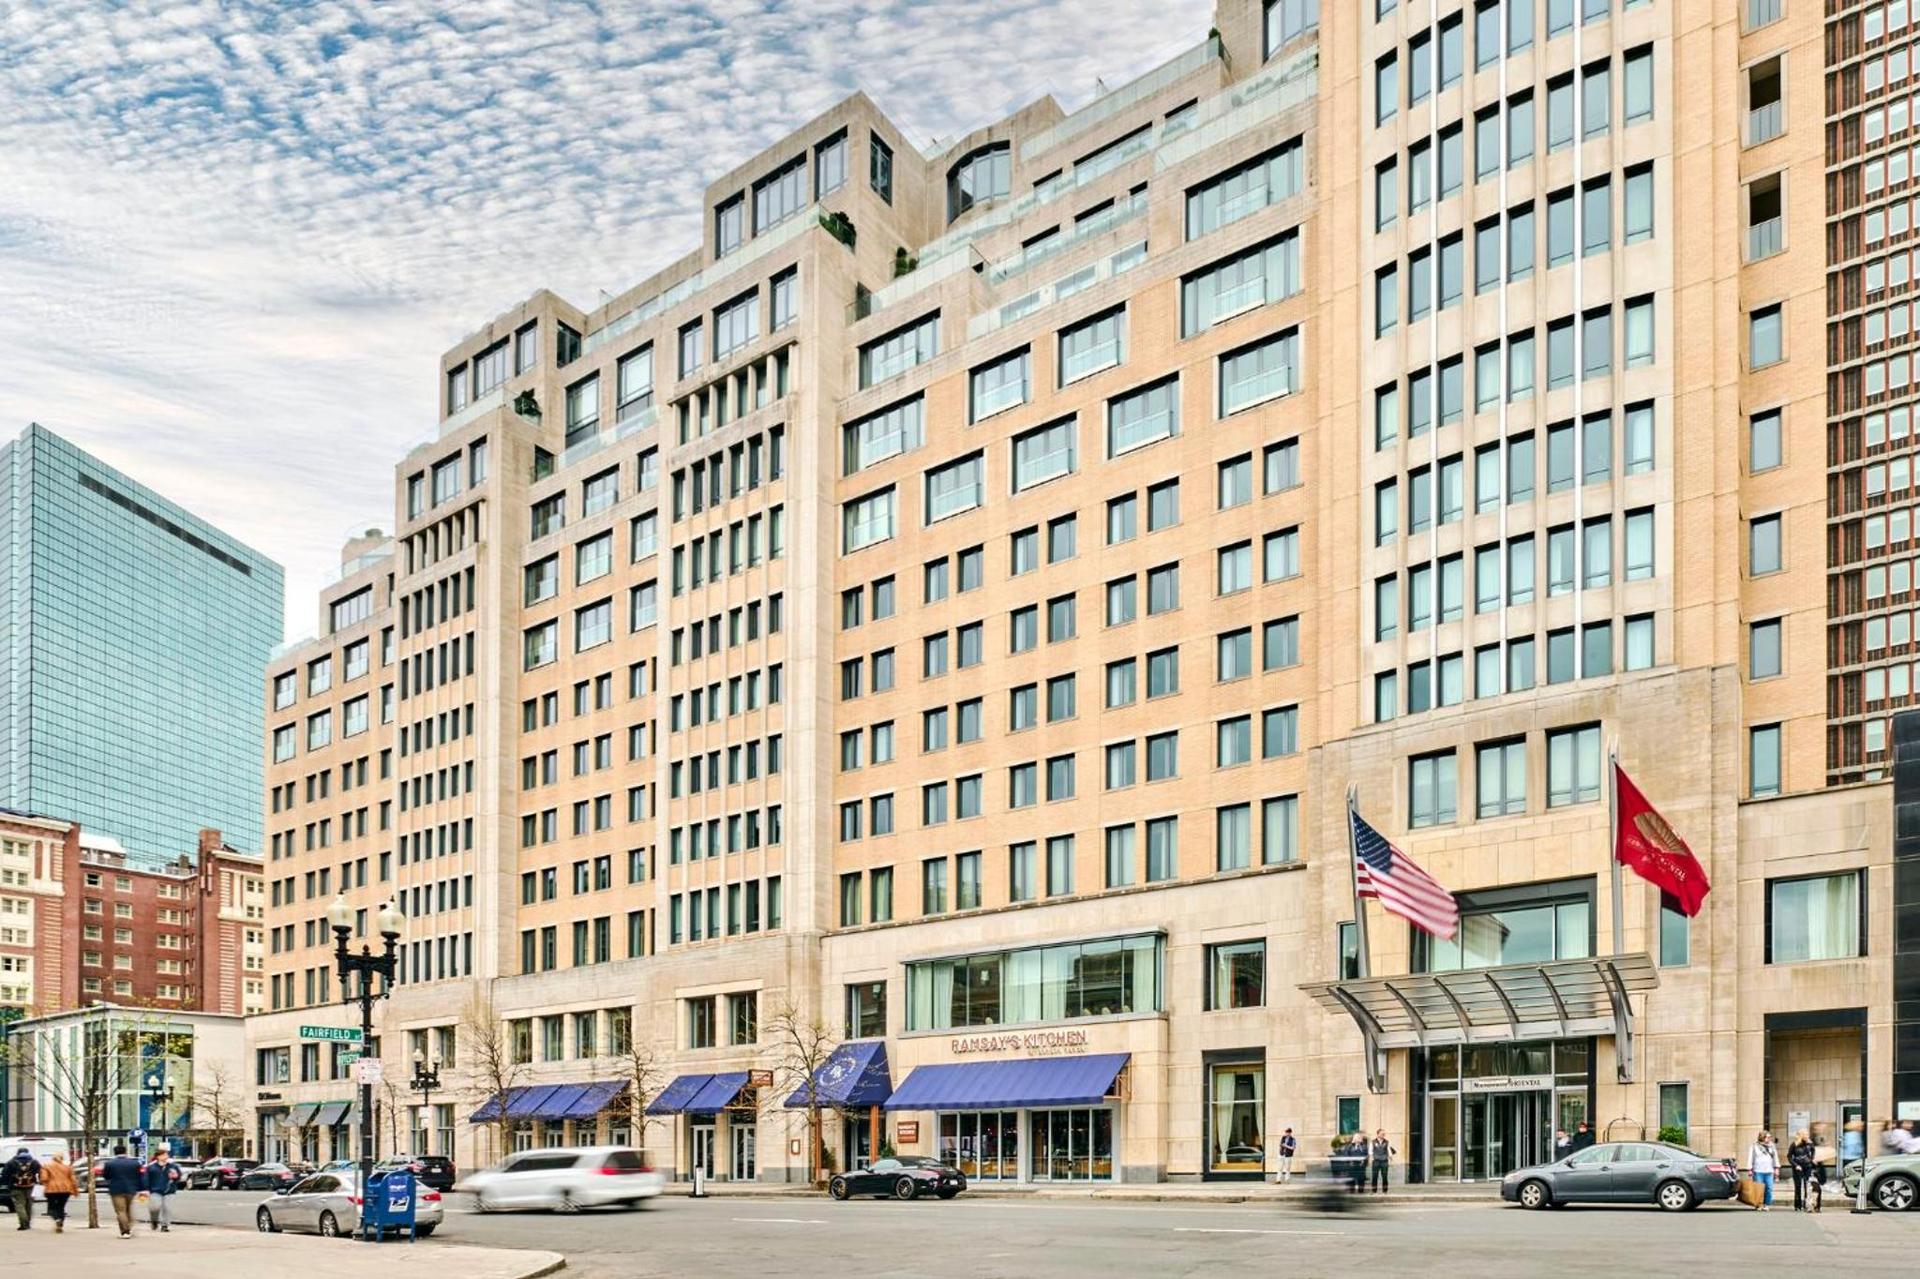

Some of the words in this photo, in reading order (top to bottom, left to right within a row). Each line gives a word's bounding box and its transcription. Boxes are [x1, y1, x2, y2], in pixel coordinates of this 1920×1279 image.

[302, 1027, 350, 1039] FAIRFIELD
[951, 1035, 1021, 1052] RAMSAY'S
[1023, 1030, 1087, 1048] KITCHEN
